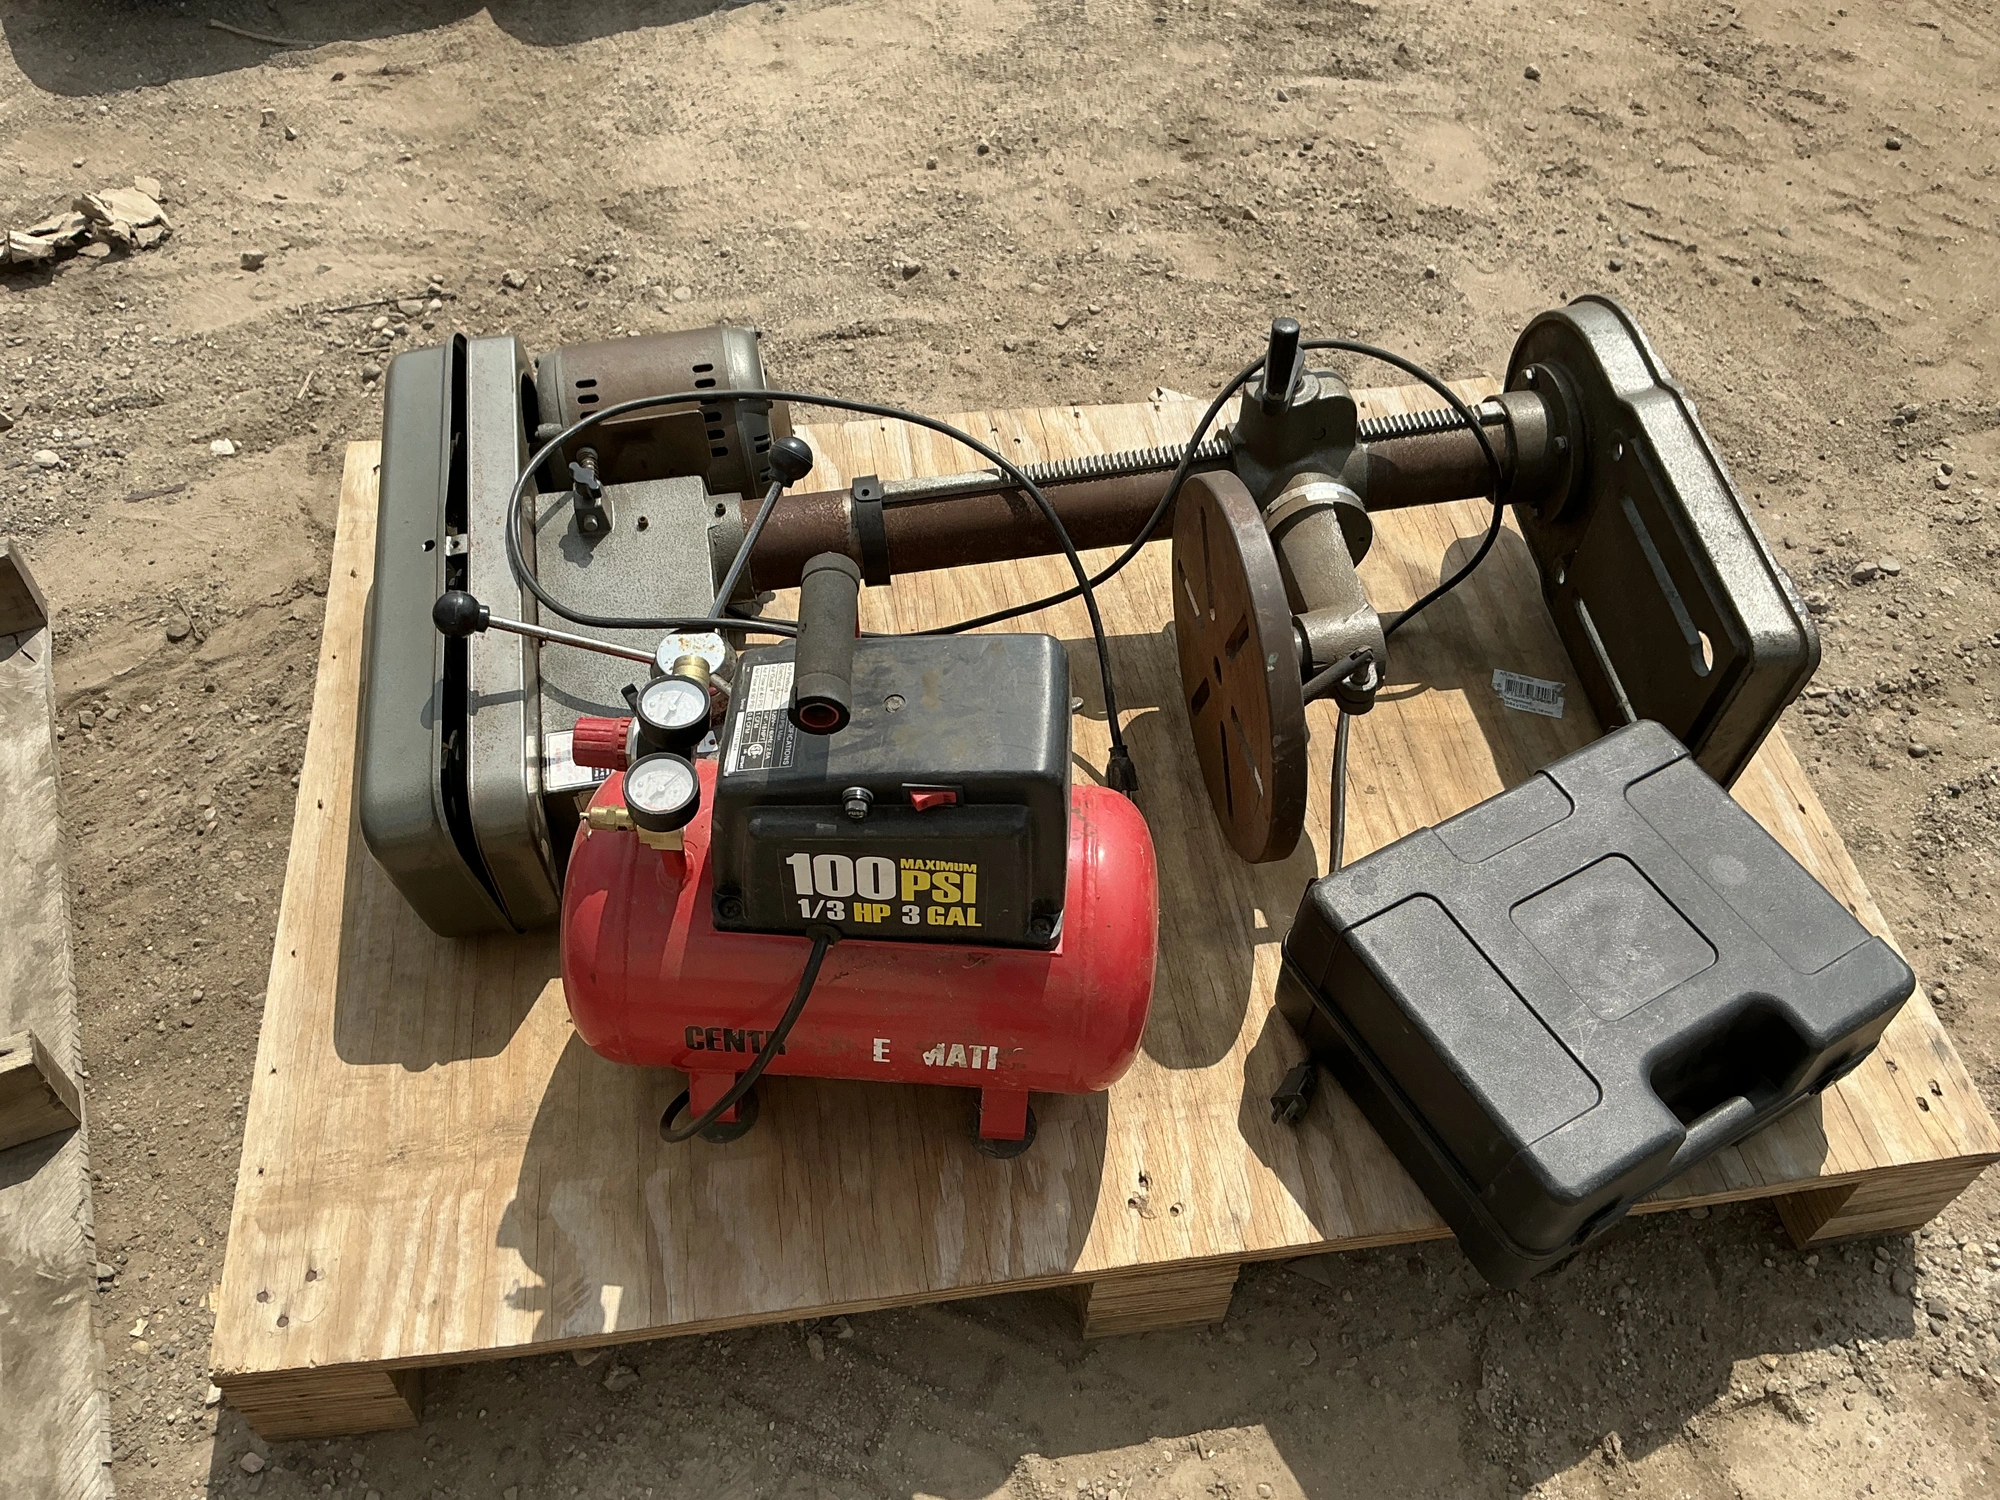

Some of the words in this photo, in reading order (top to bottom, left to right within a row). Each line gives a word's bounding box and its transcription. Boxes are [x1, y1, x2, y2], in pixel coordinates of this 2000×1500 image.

[783, 722, 794, 765] CIFICATIONS
[786, 853, 896, 900] 100
[900, 858, 977, 873] MAXIMUM
[901, 870, 976, 904] PSI
[797, 898, 845, 921] 1/3
[853, 902, 891, 923] HP
[902, 905, 920, 925] 3
[927, 906, 982, 927] GAL
